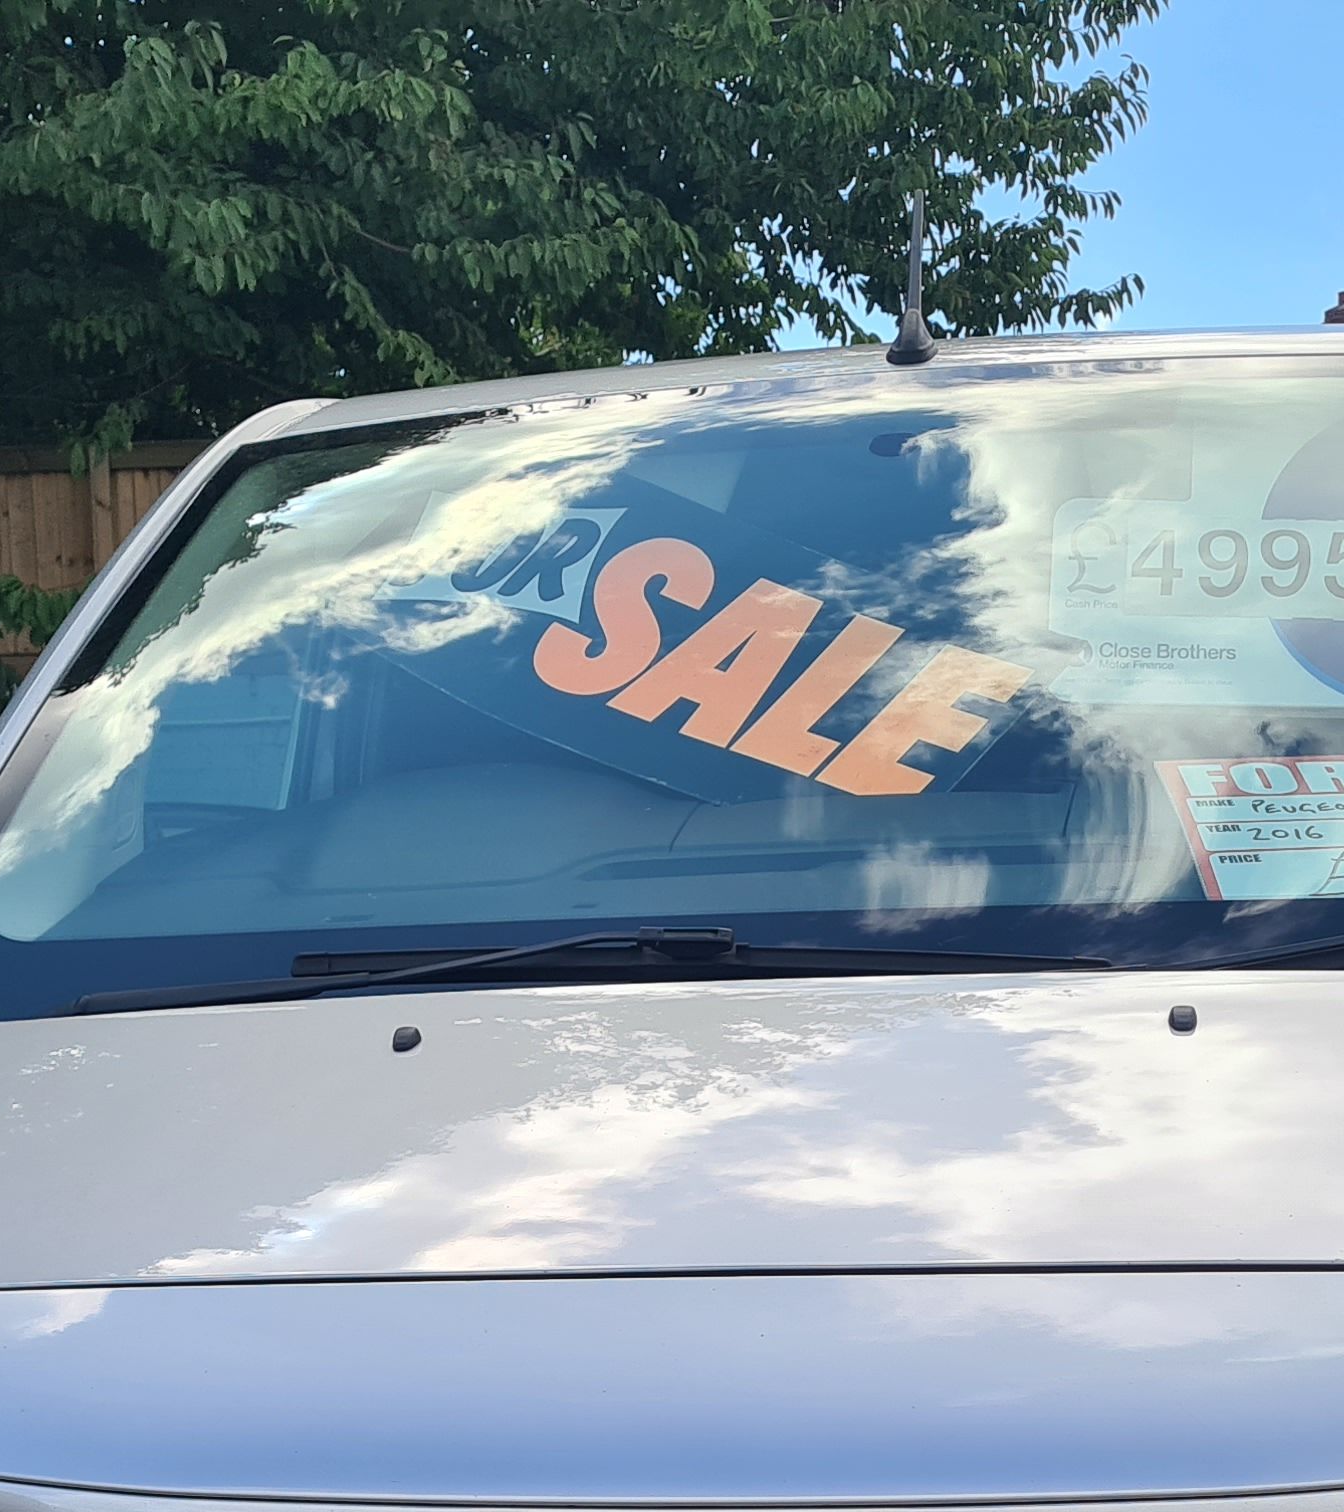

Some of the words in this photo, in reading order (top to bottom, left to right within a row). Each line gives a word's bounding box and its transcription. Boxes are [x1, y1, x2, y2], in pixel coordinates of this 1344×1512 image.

[388, 518, 602, 602] OR
[1098, 641, 1152, 660] Close
[1156, 643, 1237, 661] Brothers
[533, 537, 1035, 796] SALE
[1195, 799, 1236, 808] MAKE
[1205, 823, 1242, 833] YEAR
[1246, 825, 1325, 841] 2016
[1218, 853, 1263, 864] PRICE
